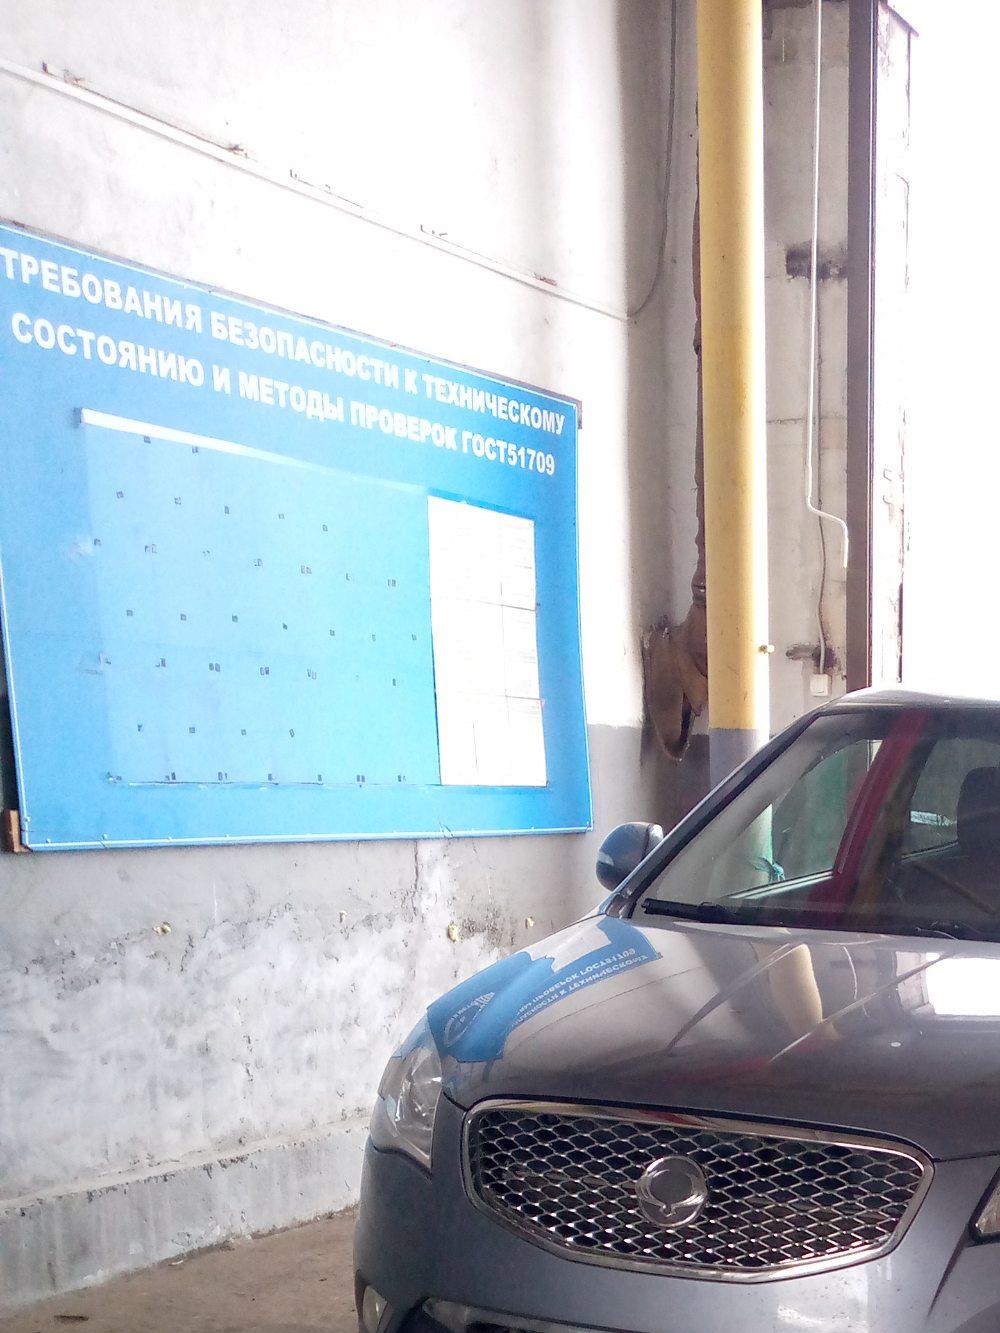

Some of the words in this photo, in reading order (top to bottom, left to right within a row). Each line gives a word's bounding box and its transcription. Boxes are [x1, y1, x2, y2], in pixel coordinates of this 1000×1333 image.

[0, 247, 202, 334] ТРЕБОВАНИЯ
[210, 311, 399, 390] БЕЗОПАСНОСТИ
[404, 367, 418, 395] К
[422, 373, 565, 436] ТЕХНИЧЕСКОМУ
[11, 312, 205, 388] СОСТОЯНИЮ
[212, 364, 232, 395] И
[238, 370, 345, 422] МЕТОДЫ
[350, 400, 457, 451] ПРОВЕРОК
[461, 430, 556, 476] ГОСТ51709
